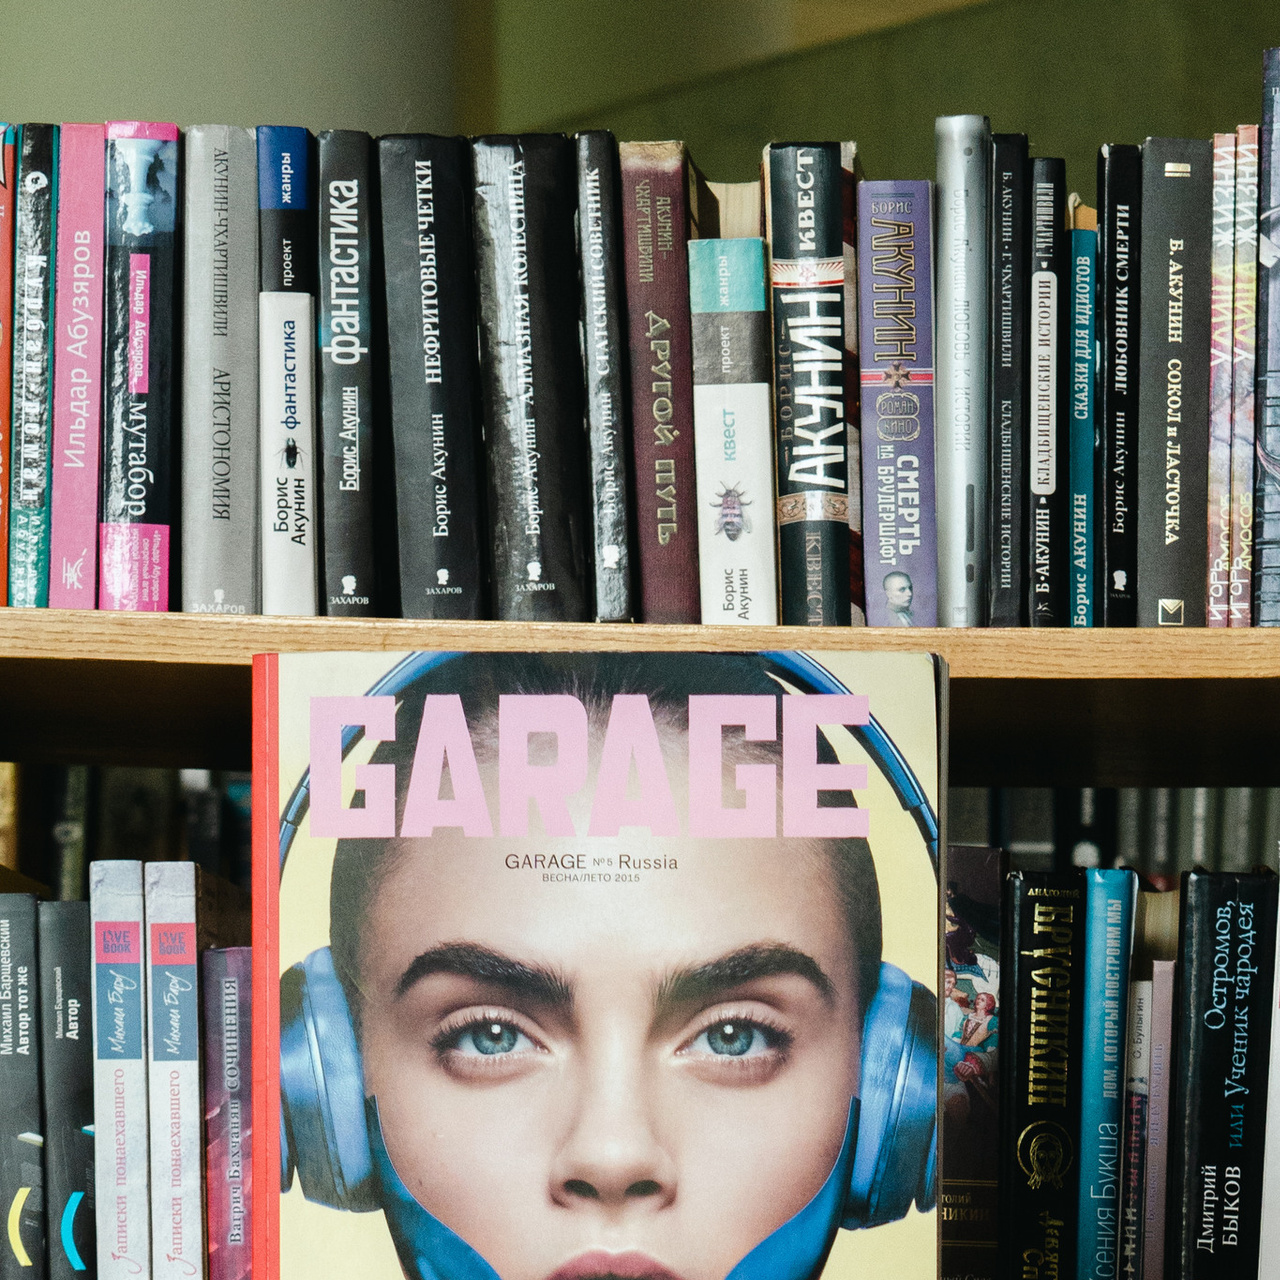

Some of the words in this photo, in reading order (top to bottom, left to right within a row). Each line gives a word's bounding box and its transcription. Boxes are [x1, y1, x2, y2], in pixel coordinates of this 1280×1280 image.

[282, 152, 292, 204] жанры
[414, 159, 436, 231] ЧЕТКИ
[871, 202, 912, 214] БОРИС
[213, 148, 229, 337] АКУНИН-ЧХАРТИШВИЛИ
[282, 238, 292, 287] проект
[322, 179, 368, 365] фантастика
[1115, 204, 1130, 282] СМЕРТИ
[1168, 238, 1184, 255] Б.
[66, 230, 94, 359] Абузяров
[418, 234, 443, 384] НЕФРИТОВЫЕ
[871, 217, 917, 362] АКУНИН
[1075, 256, 1090, 325] ИДИОТОВ
[1168, 260, 1184, 343] АКУНИН
[1075, 329, 1091, 360] ДЛЯ
[1114, 285, 1129, 395] ЛЮБОВНИК
[280, 320, 299, 430] фантастика
[644, 310, 681, 446] ДРУГОЙ
[781, 292, 845, 489] АКУНИН
[1074, 362, 1089, 420] СКАЗКИ
[64, 367, 92, 468] Ильдар
[212, 367, 231, 521] АРИСТОНОМИЯ
[339, 386, 360, 439] Акунин
[1112, 412, 1128, 477] Акунин
[339, 443, 360, 491] Борис
[430, 413, 449, 481] Акунин
[521, 418, 541, 483] Акунин
[273, 476, 289, 533] Борис
[291, 478, 309, 546] Акунин
[431, 485, 451, 537] Борис
[525, 486, 544, 536] Борис
[655, 459, 678, 546] ПУТЬ
[896, 454, 921, 556] СМЕРТЬ
[1073, 494, 1087, 571] АКУНИН
[1112, 480, 1127, 534] Борис
[192, 603, 246, 614] ЗАХАРОВ
[723, 568, 736, 612] Борис
[738, 568, 750, 621] Акунин
[1073, 574, 1089, 627] Борис
[309, 693, 869, 838] GARAGE
[505, 853, 587, 870] GARAGE
[619, 853, 678, 870] Russia
[542, 873, 611, 883] ВЕСНА/ЛЕТО
[614, 873, 640, 882] 2015
[1109, 899, 1122, 924] МЫ
[18, 966, 28, 986] же
[103, 942, 132, 954] BOOK
[1105, 926, 1122, 998] ПОСТРОИМ
[1203, 901, 1237, 1031] Остромов,
[1235, 902, 1260, 1004] чародея
[17, 988, 28, 1011] тот
[66, 998, 81, 1040] Автор
[1020, 902, 1074, 1106] БРУСНИКИН
[1104, 1000, 1120, 1062] КОТОРЫЙ
[17, 1013, 32, 1055] Автор
[224, 979, 240, 1091] СОЧИНЕНИЯ
[1225, 1005, 1250, 1099] Ученик
[1103, 1065, 1119, 1099] ДОМ,
[228, 1100, 243, 1181] Бахчанян
[1230, 1103, 1245, 1149] или
[1090, 1122, 1119, 1200] Букша
[229, 1184, 244, 1244] Вагрич
[1197, 1164, 1217, 1254] Дмитрий
[1222, 1165, 1242, 1247] БЫКОВ
